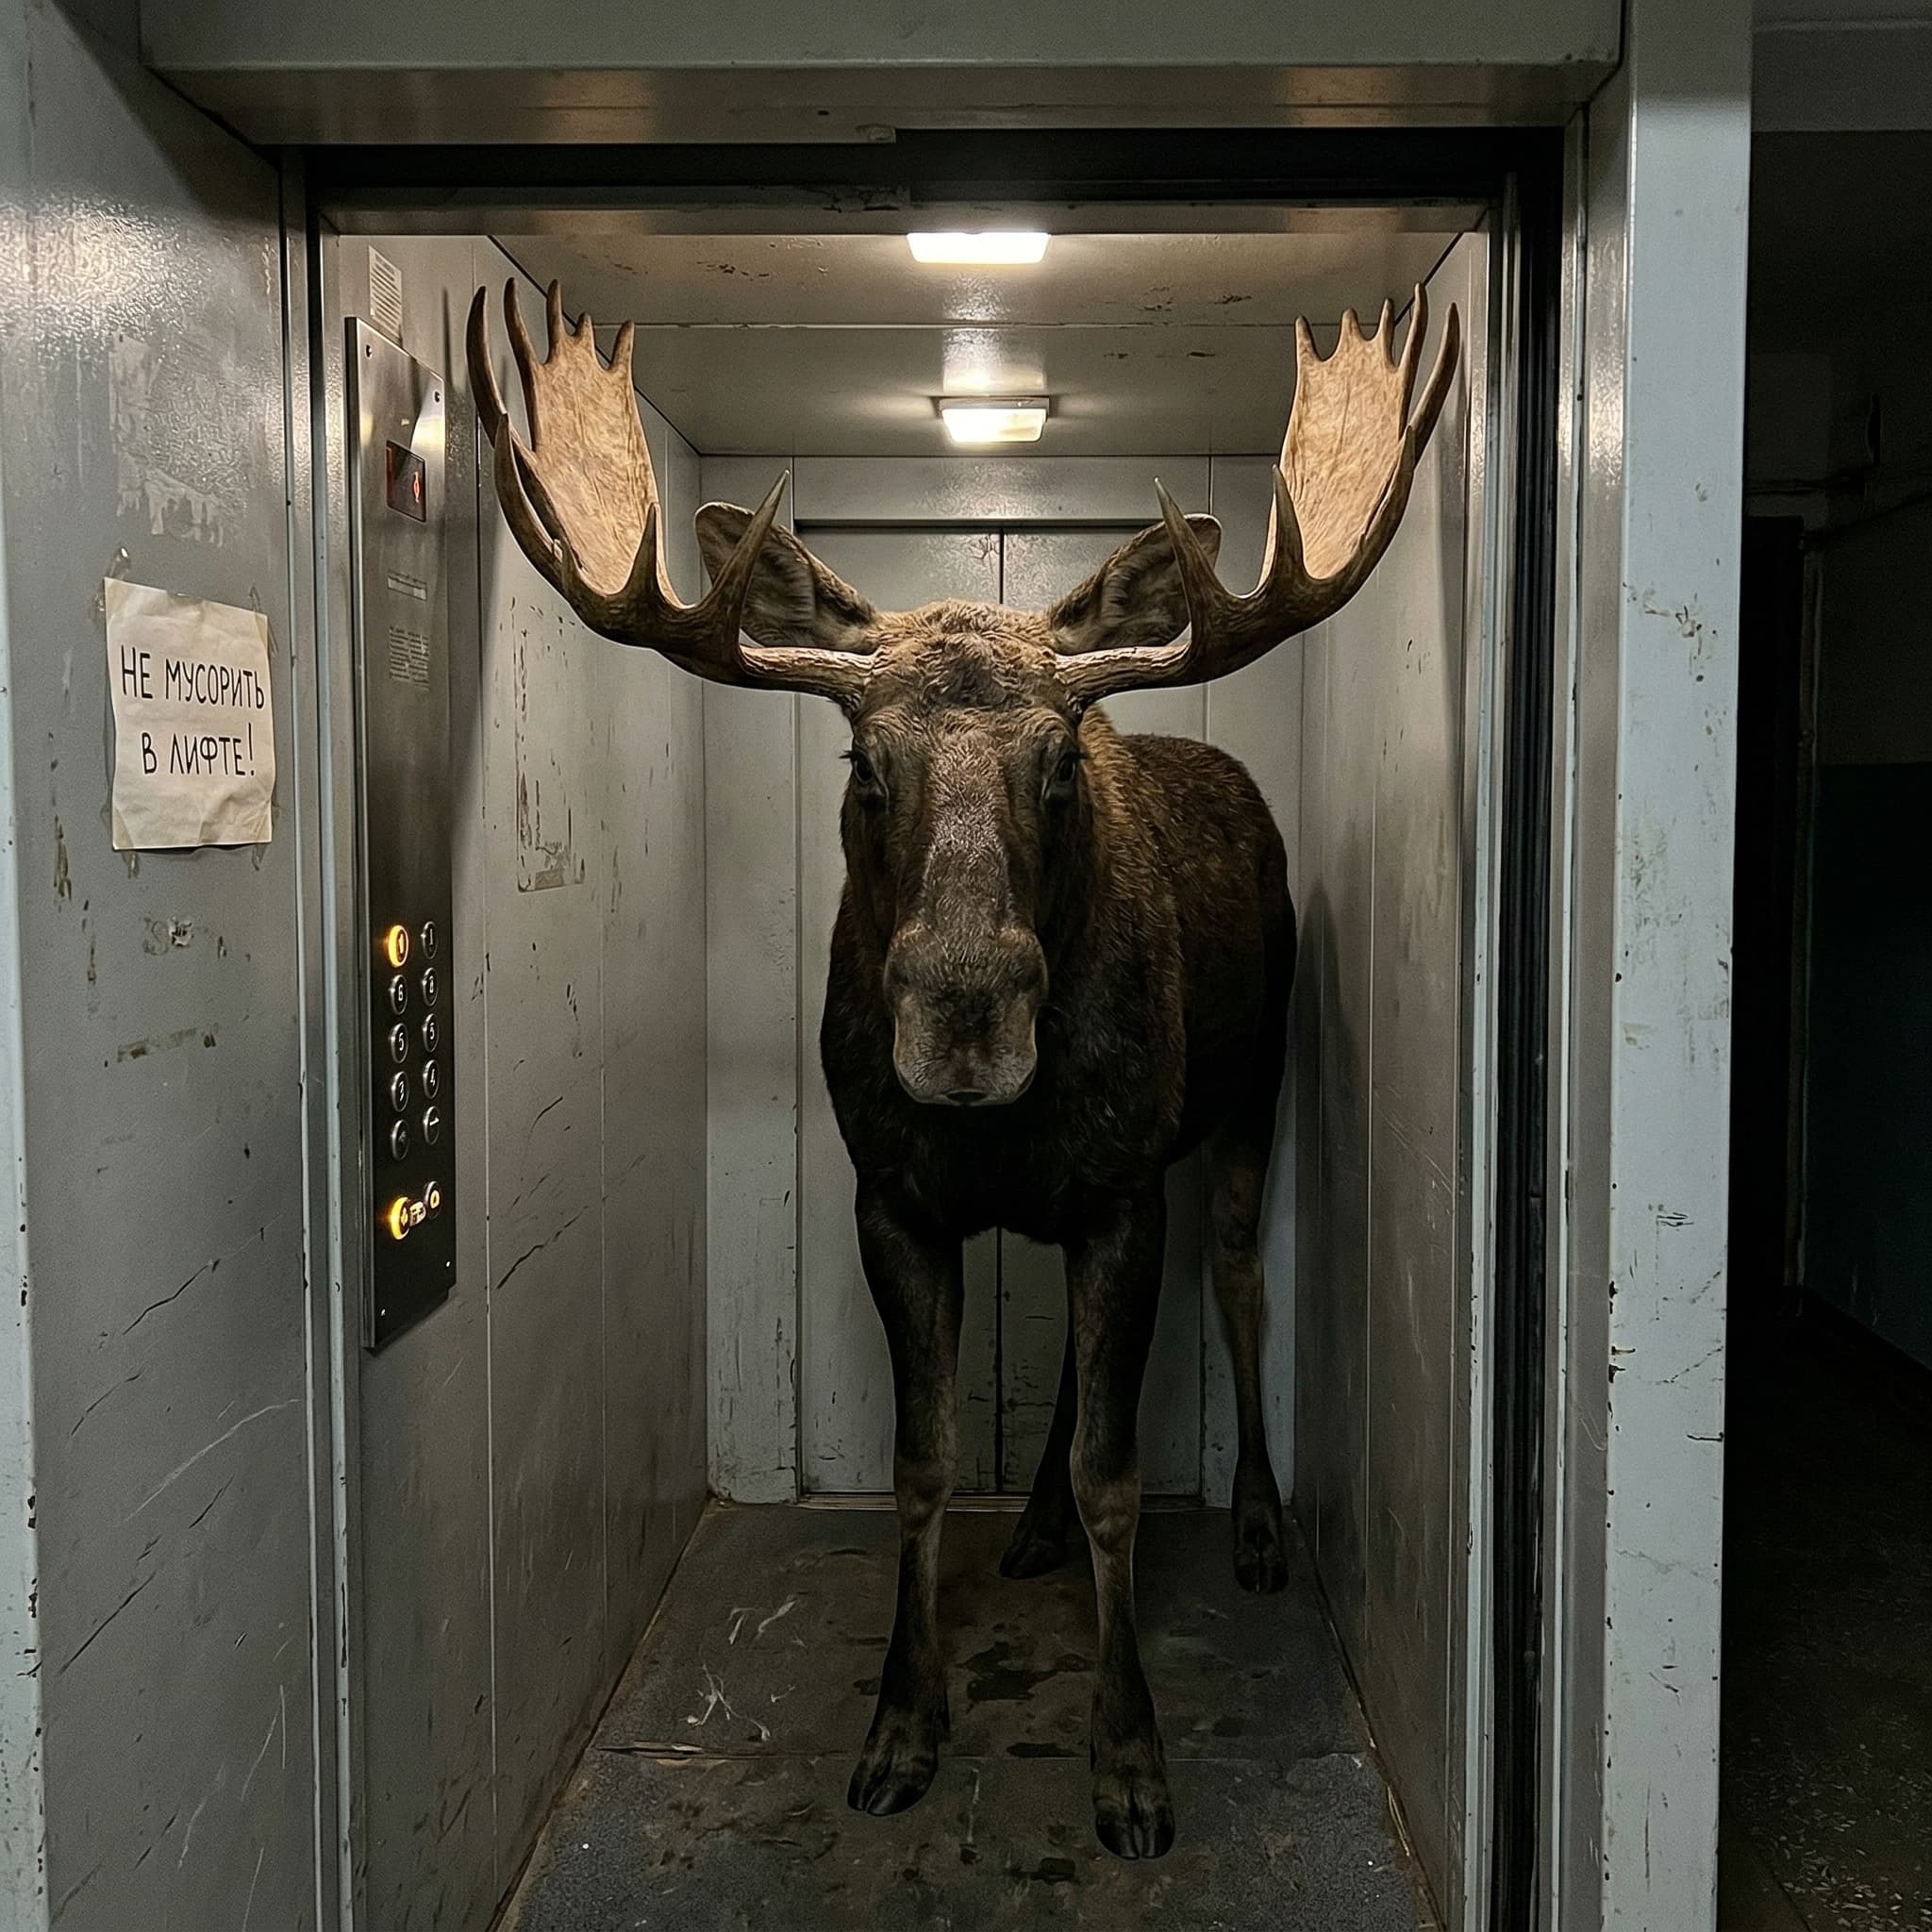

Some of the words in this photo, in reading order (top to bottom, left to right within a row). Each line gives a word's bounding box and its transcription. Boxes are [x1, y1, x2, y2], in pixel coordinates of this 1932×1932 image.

[121, 644, 153, 700] НЕ
[165, 658, 265, 710] МУСОРИТЬ
[142, 732, 158, 774] В
[170, 723, 257, 776] ЛИФТЕ!
